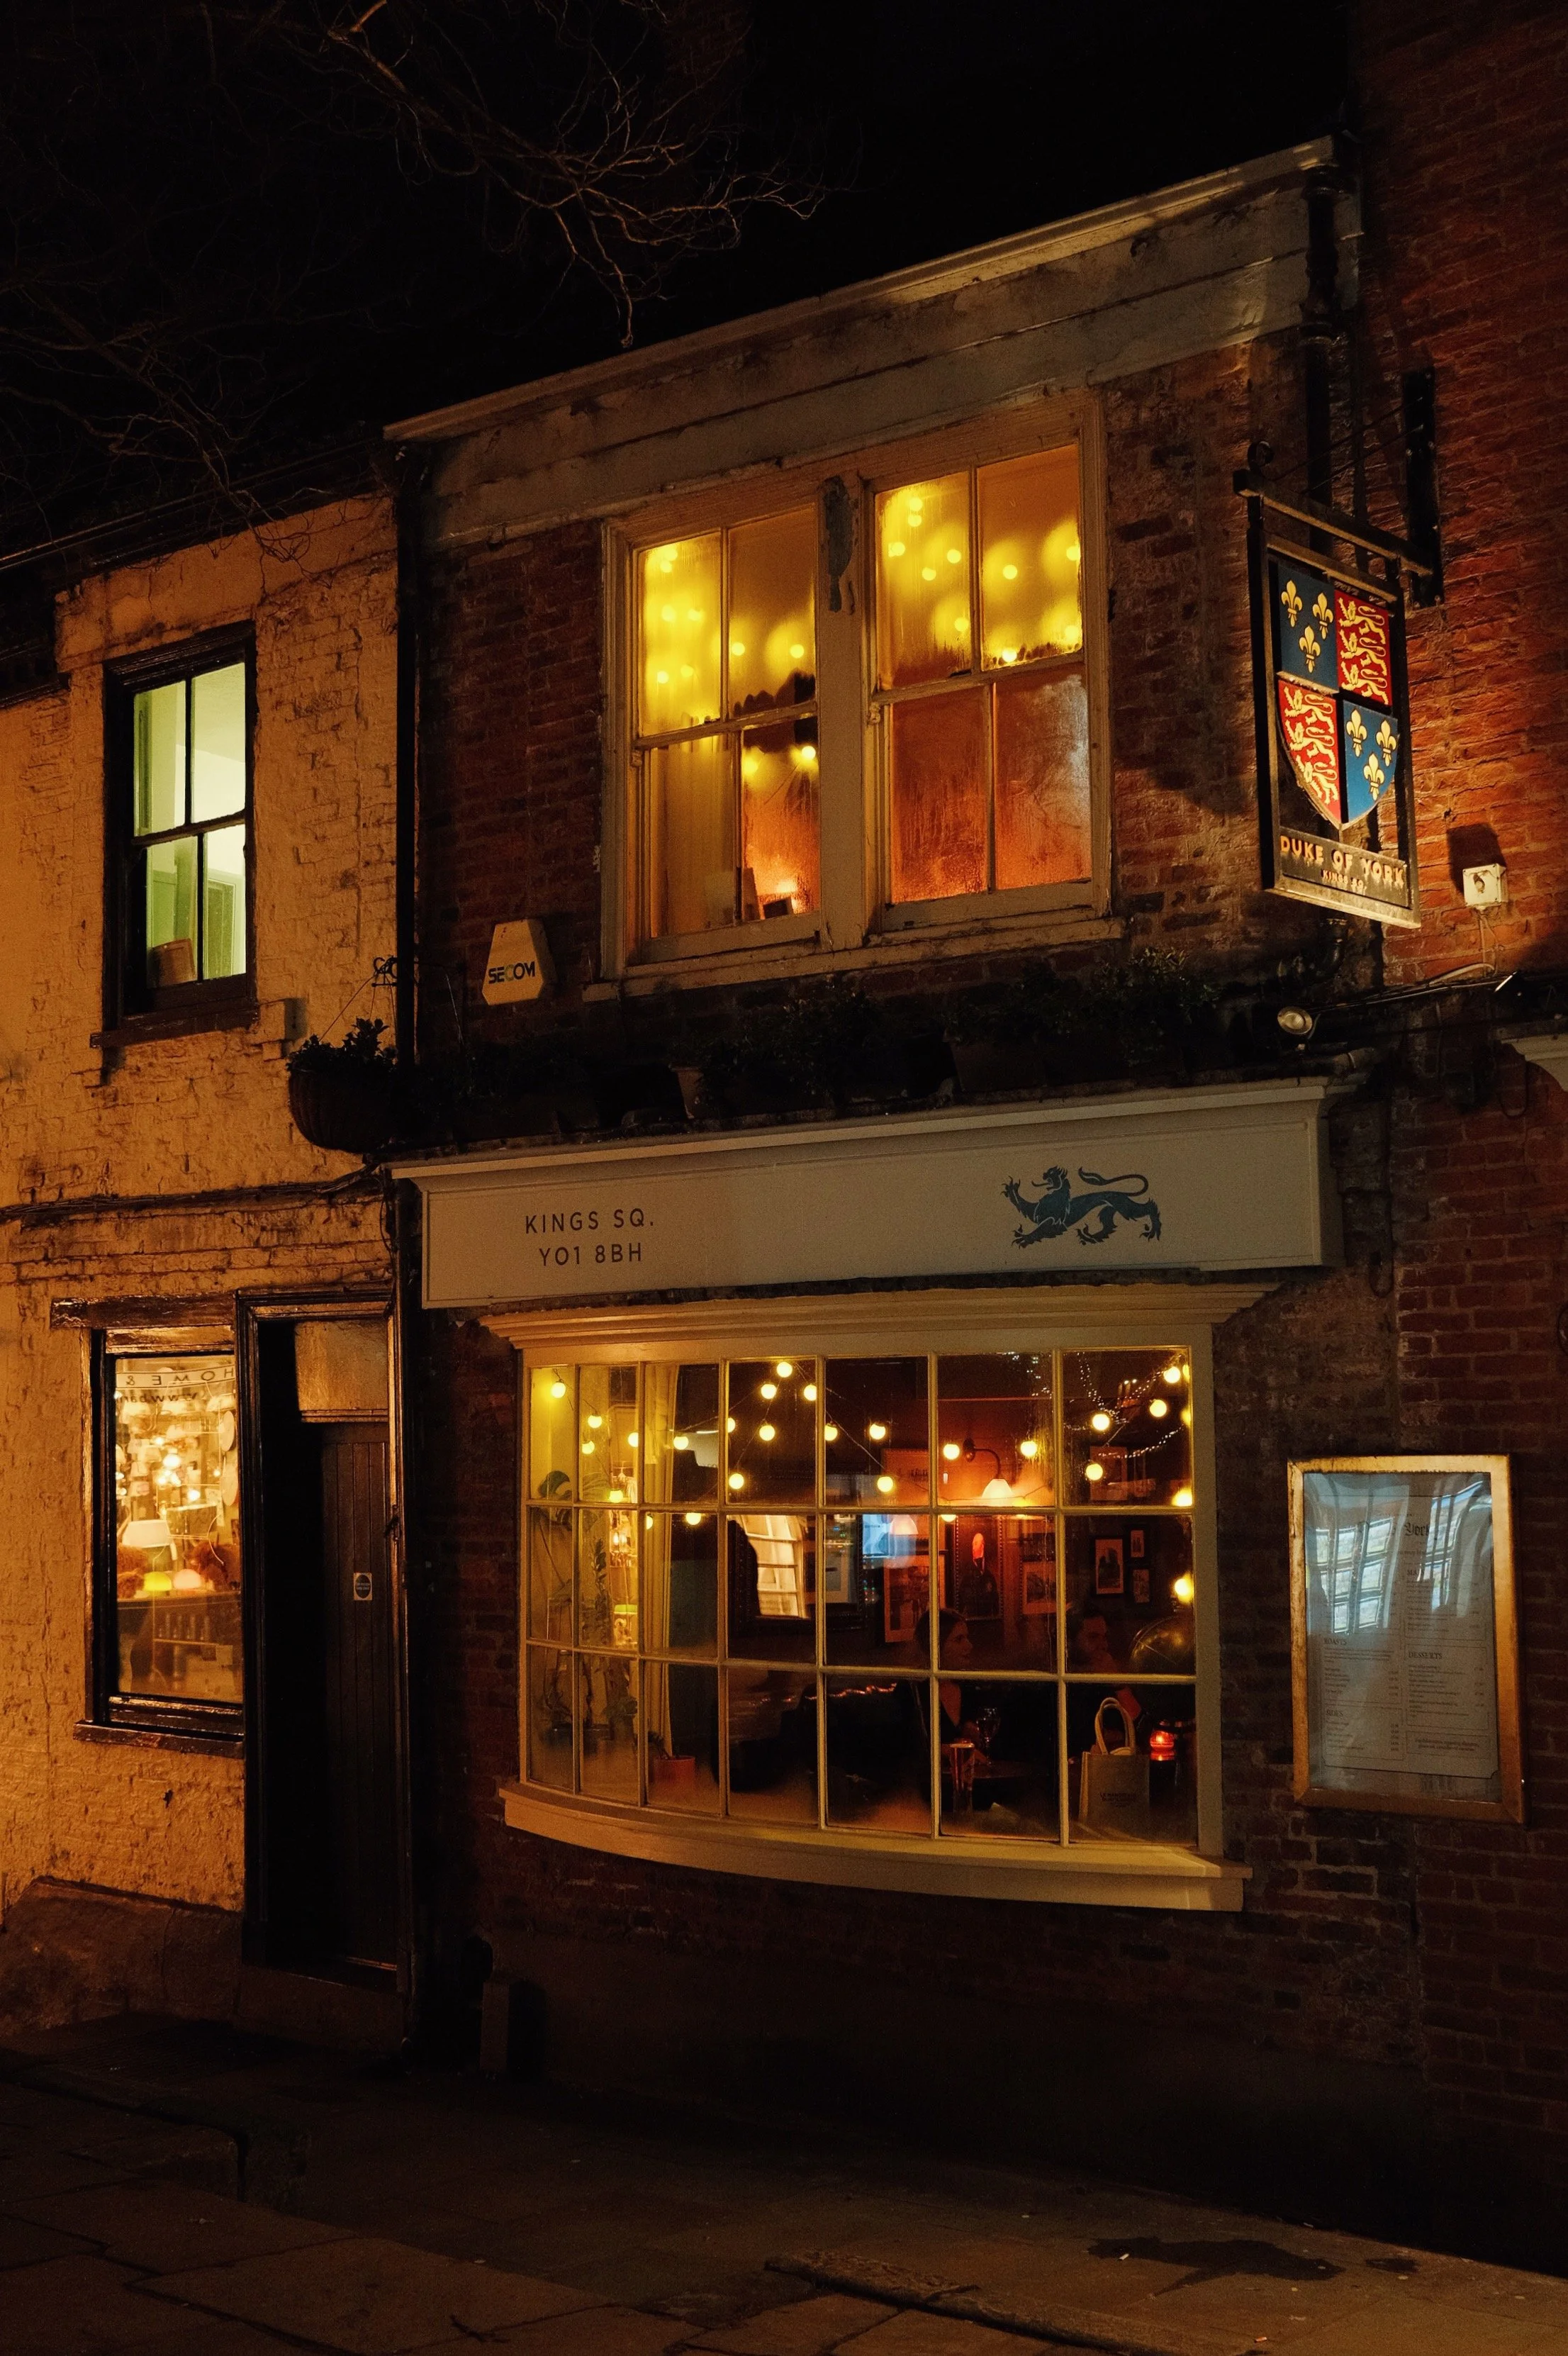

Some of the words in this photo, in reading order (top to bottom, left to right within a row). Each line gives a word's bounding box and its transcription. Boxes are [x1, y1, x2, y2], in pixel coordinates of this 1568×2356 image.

[1279, 835, 1324, 862] DUKE
[1331, 849, 1353, 869] OF
[1360, 857, 1404, 886] YORK
[1321, 869, 1348, 885] KINGS
[488, 961, 535, 984] SECOM
[525, 1210, 599, 1234] KINGS
[613, 1207, 654, 1228] SQ.
[539, 1246, 580, 1266] YO1
[595, 1242, 642, 1264] 8BH
[1408, 1651, 1443, 1660] DESSERTS
